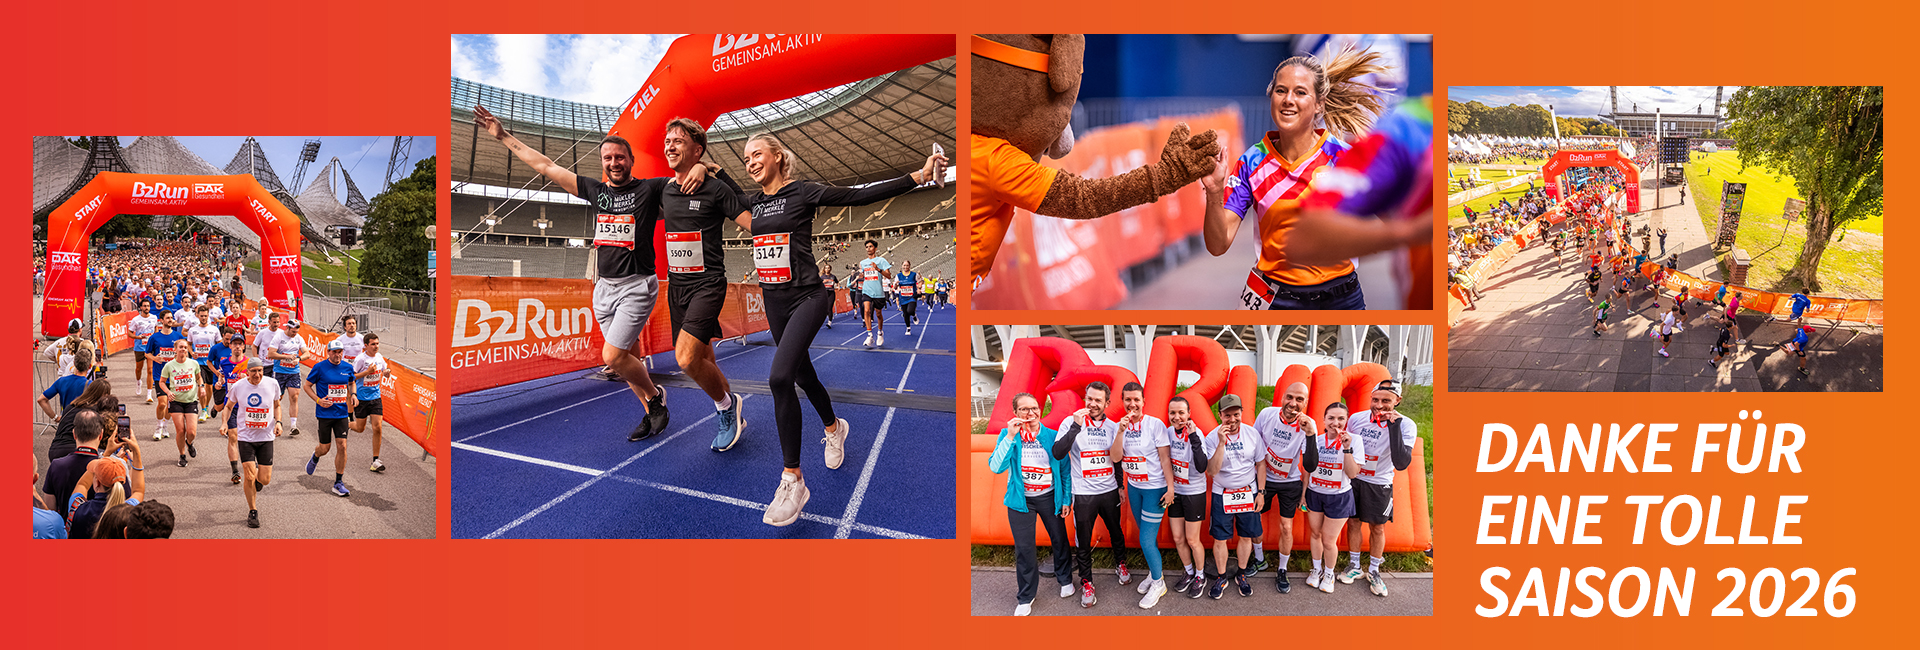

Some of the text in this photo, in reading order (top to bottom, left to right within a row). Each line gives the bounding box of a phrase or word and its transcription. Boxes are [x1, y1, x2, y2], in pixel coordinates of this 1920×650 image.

[630, 84, 660, 121] ZIEL
[131, 181, 189, 199] B2Run
[194, 183, 224, 194] DAK
[74, 195, 102, 221] START
[250, 199, 278, 224] START
[599, 223, 631, 234] 15146
[51, 251, 82, 265] DAK
[670, 249, 693, 258] 55070
[269, 255, 298, 267] DAK
[451, 298, 593, 348] B2Run
[1025, 472, 1043, 480] 387
[1318, 467, 1333, 476] 390
